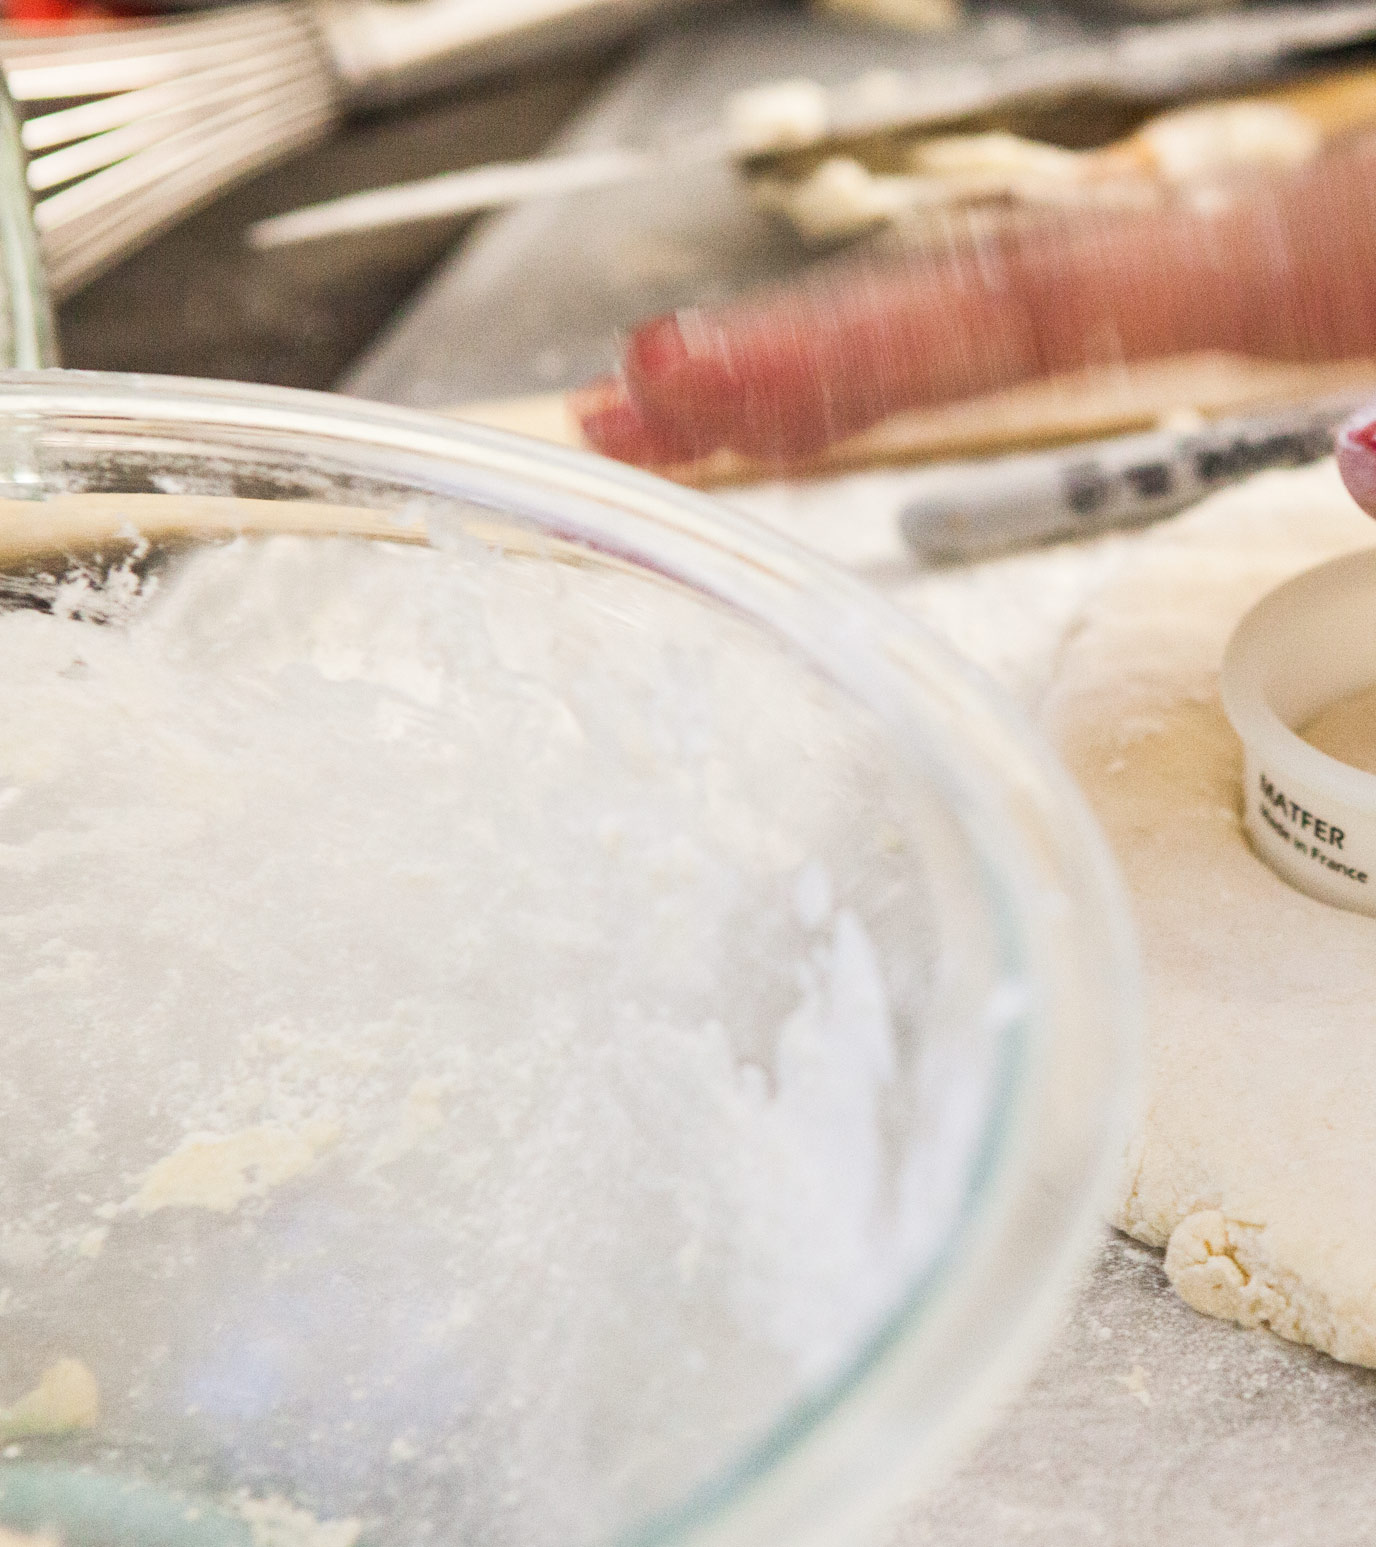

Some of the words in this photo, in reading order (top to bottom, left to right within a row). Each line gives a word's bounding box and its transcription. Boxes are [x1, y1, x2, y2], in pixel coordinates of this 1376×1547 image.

[1260, 772, 1345, 849] MATFER
[1293, 837, 1308, 856] in
[1310, 847, 1369, 884] France
